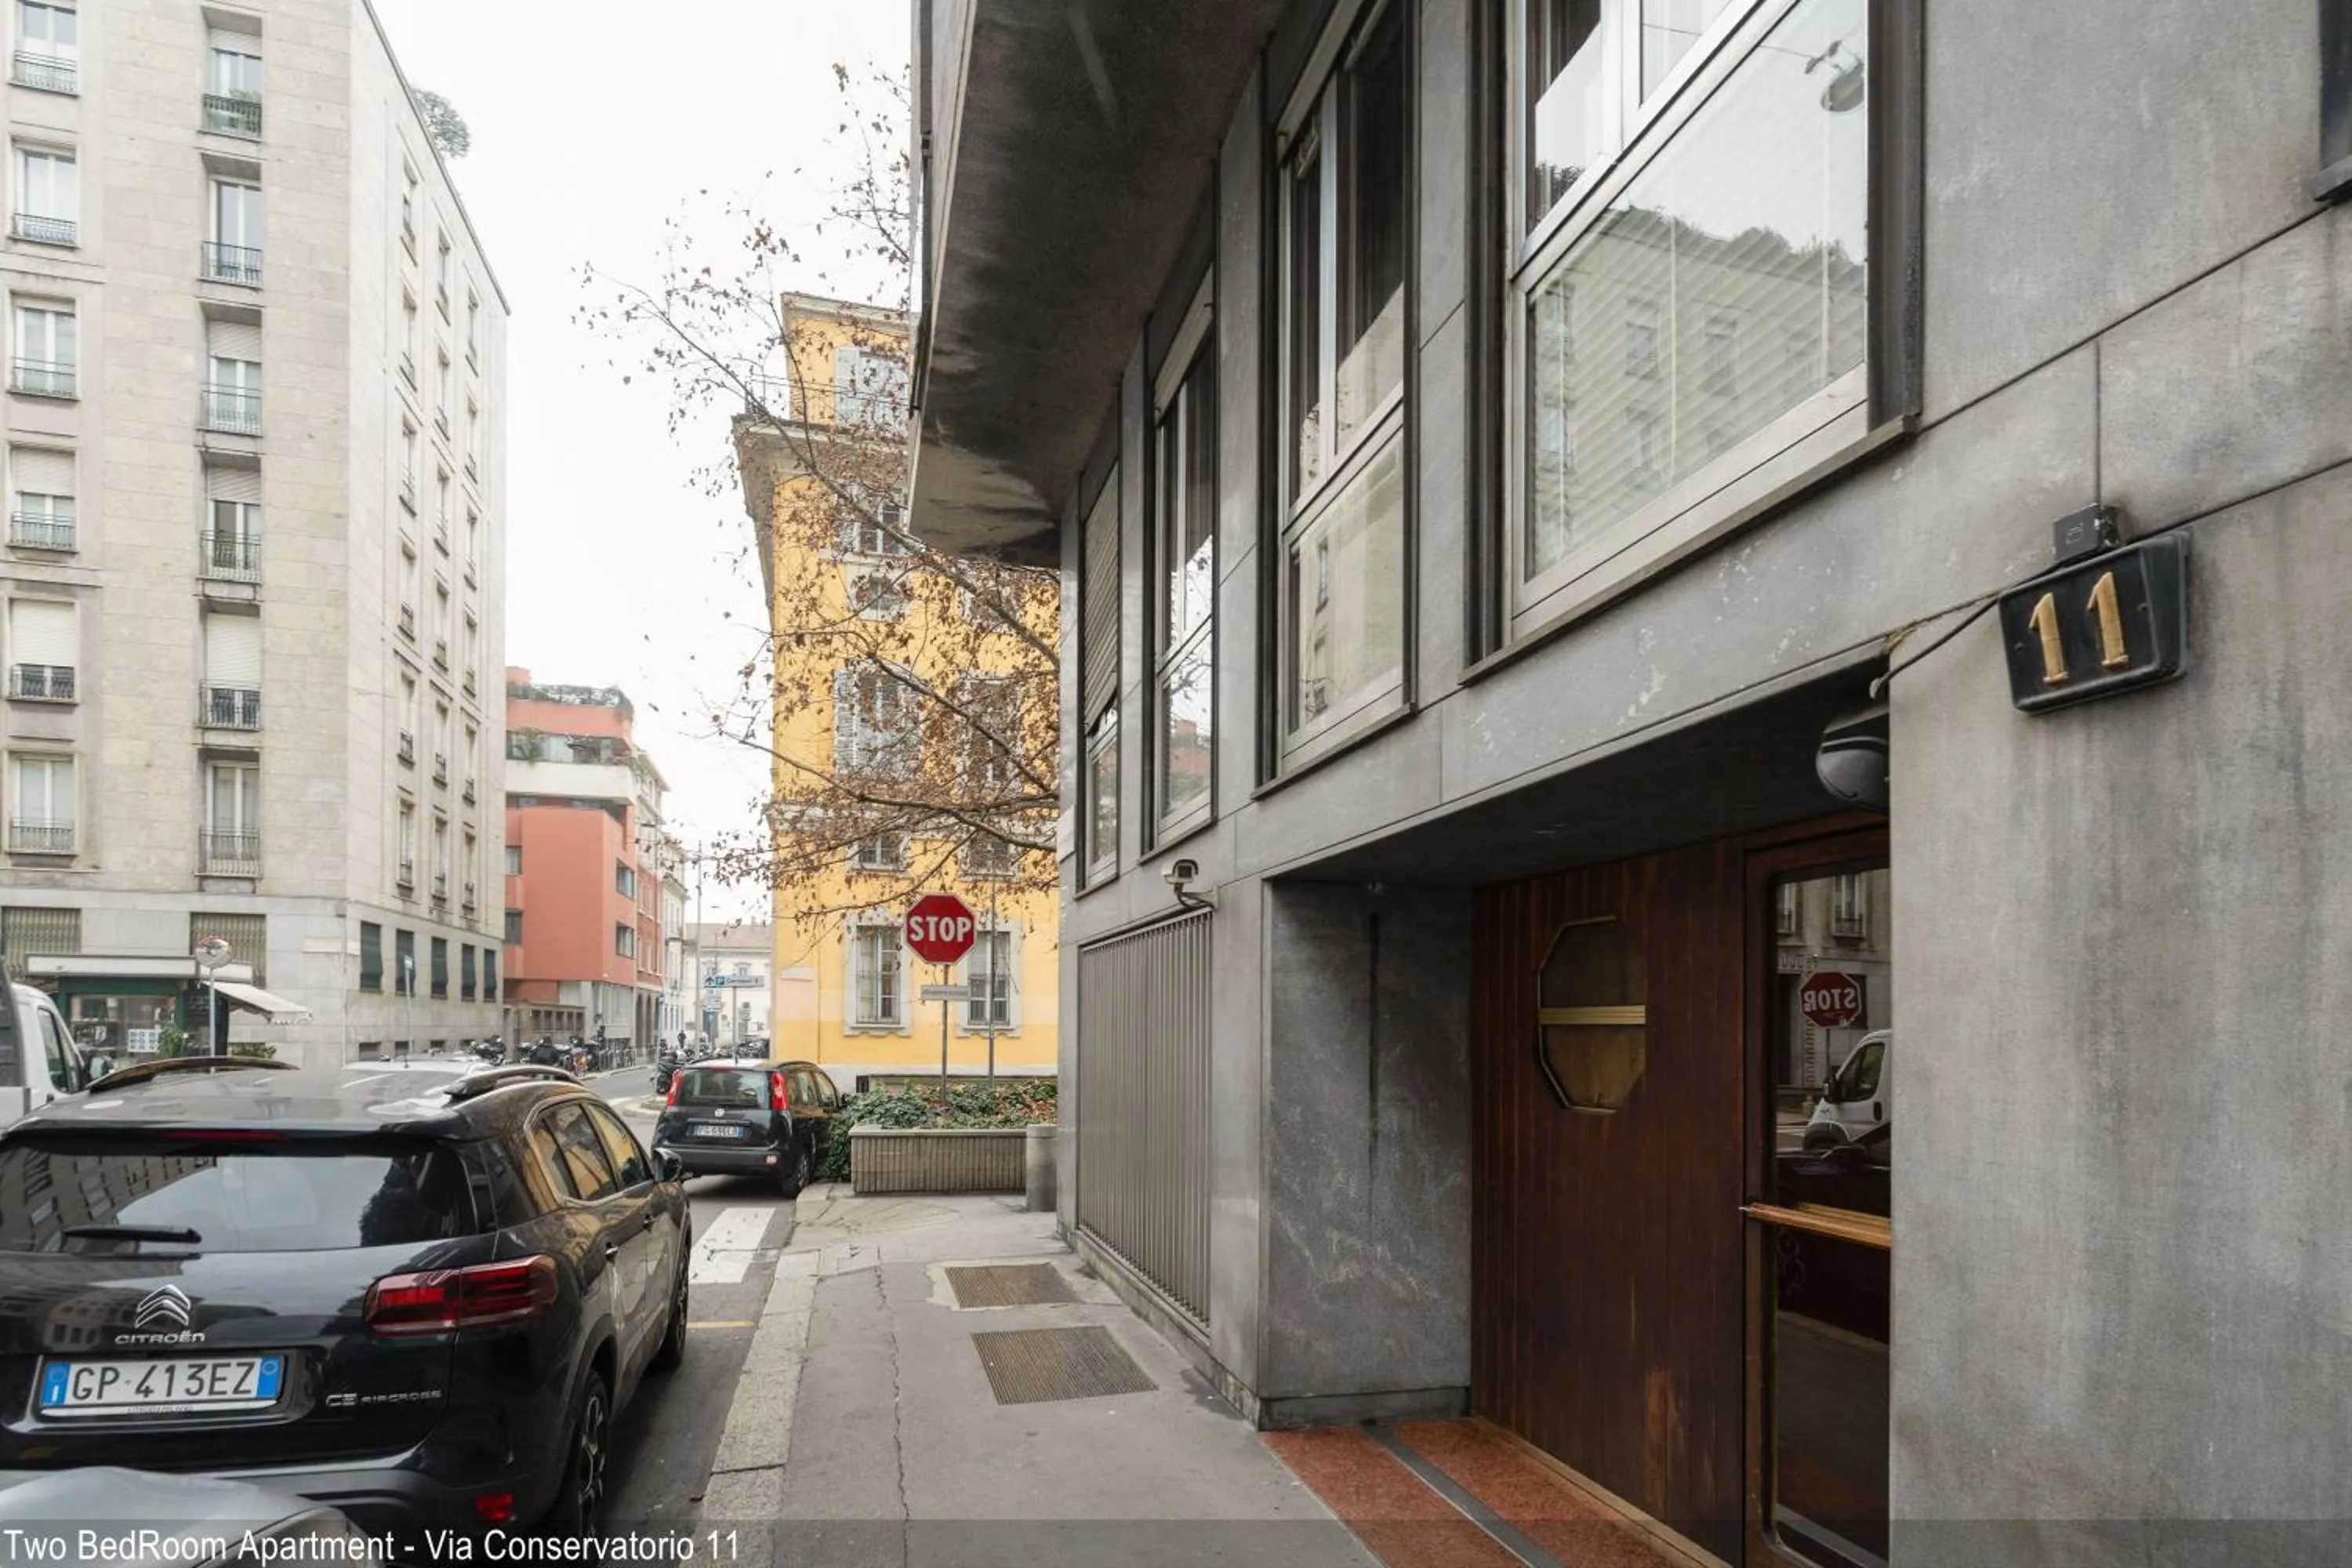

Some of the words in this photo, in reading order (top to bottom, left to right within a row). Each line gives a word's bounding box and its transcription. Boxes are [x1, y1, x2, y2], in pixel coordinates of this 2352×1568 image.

[2029, 571, 2129, 683] 11
[909, 916, 971, 942] STOP
[71, 1366, 121, 1400] GP
[134, 1361, 257, 1399] 413EZ
